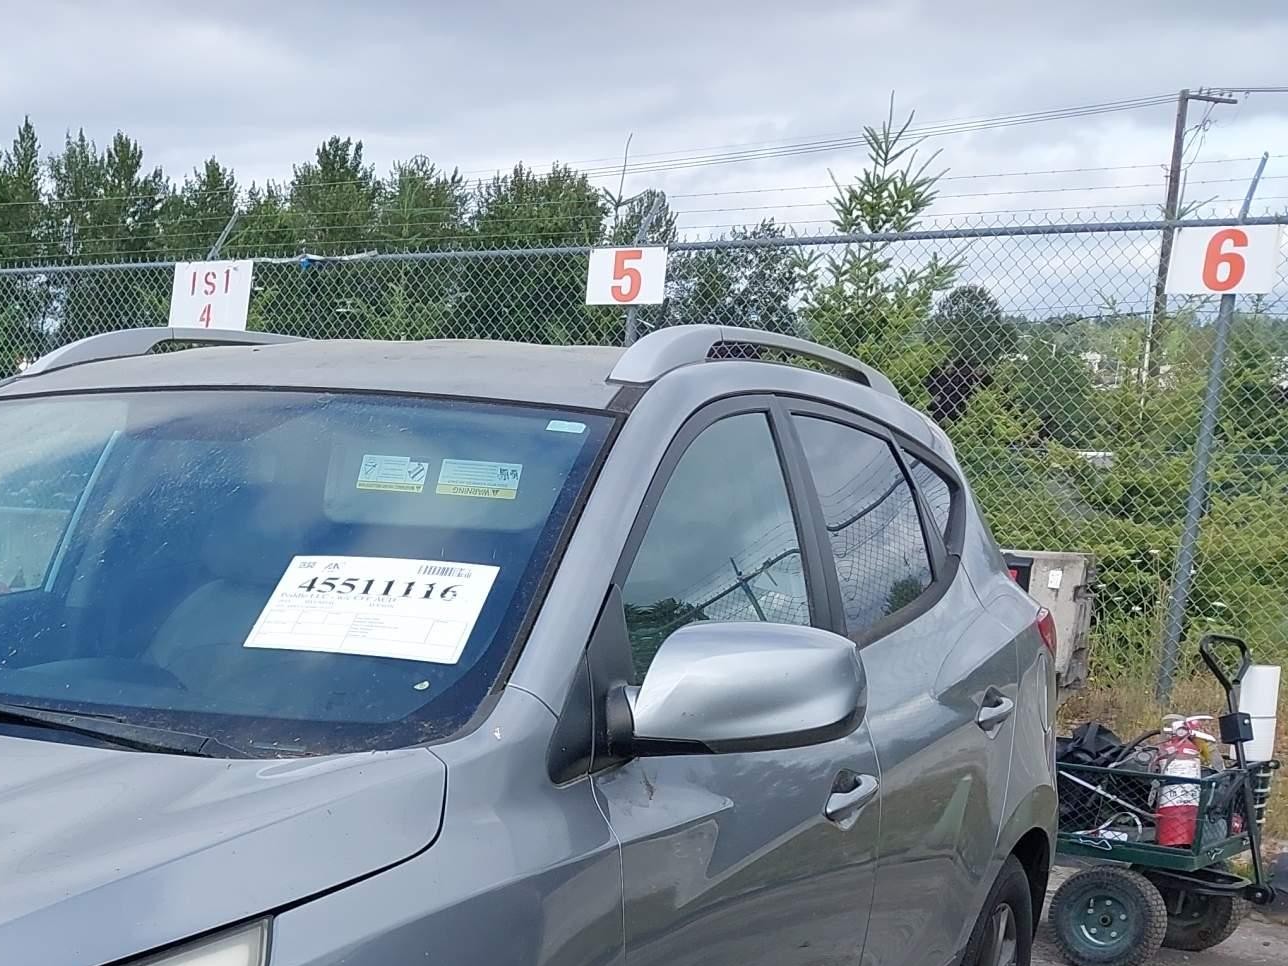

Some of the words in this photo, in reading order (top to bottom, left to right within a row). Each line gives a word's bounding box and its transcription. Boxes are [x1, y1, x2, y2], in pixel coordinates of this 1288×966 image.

[1202, 228, 1249, 292] 6
[610, 249, 643, 303] 5
[199, 303, 212, 329] 4
[451, 486, 492, 498] WARNING
[297, 575, 464, 602] 45511116
